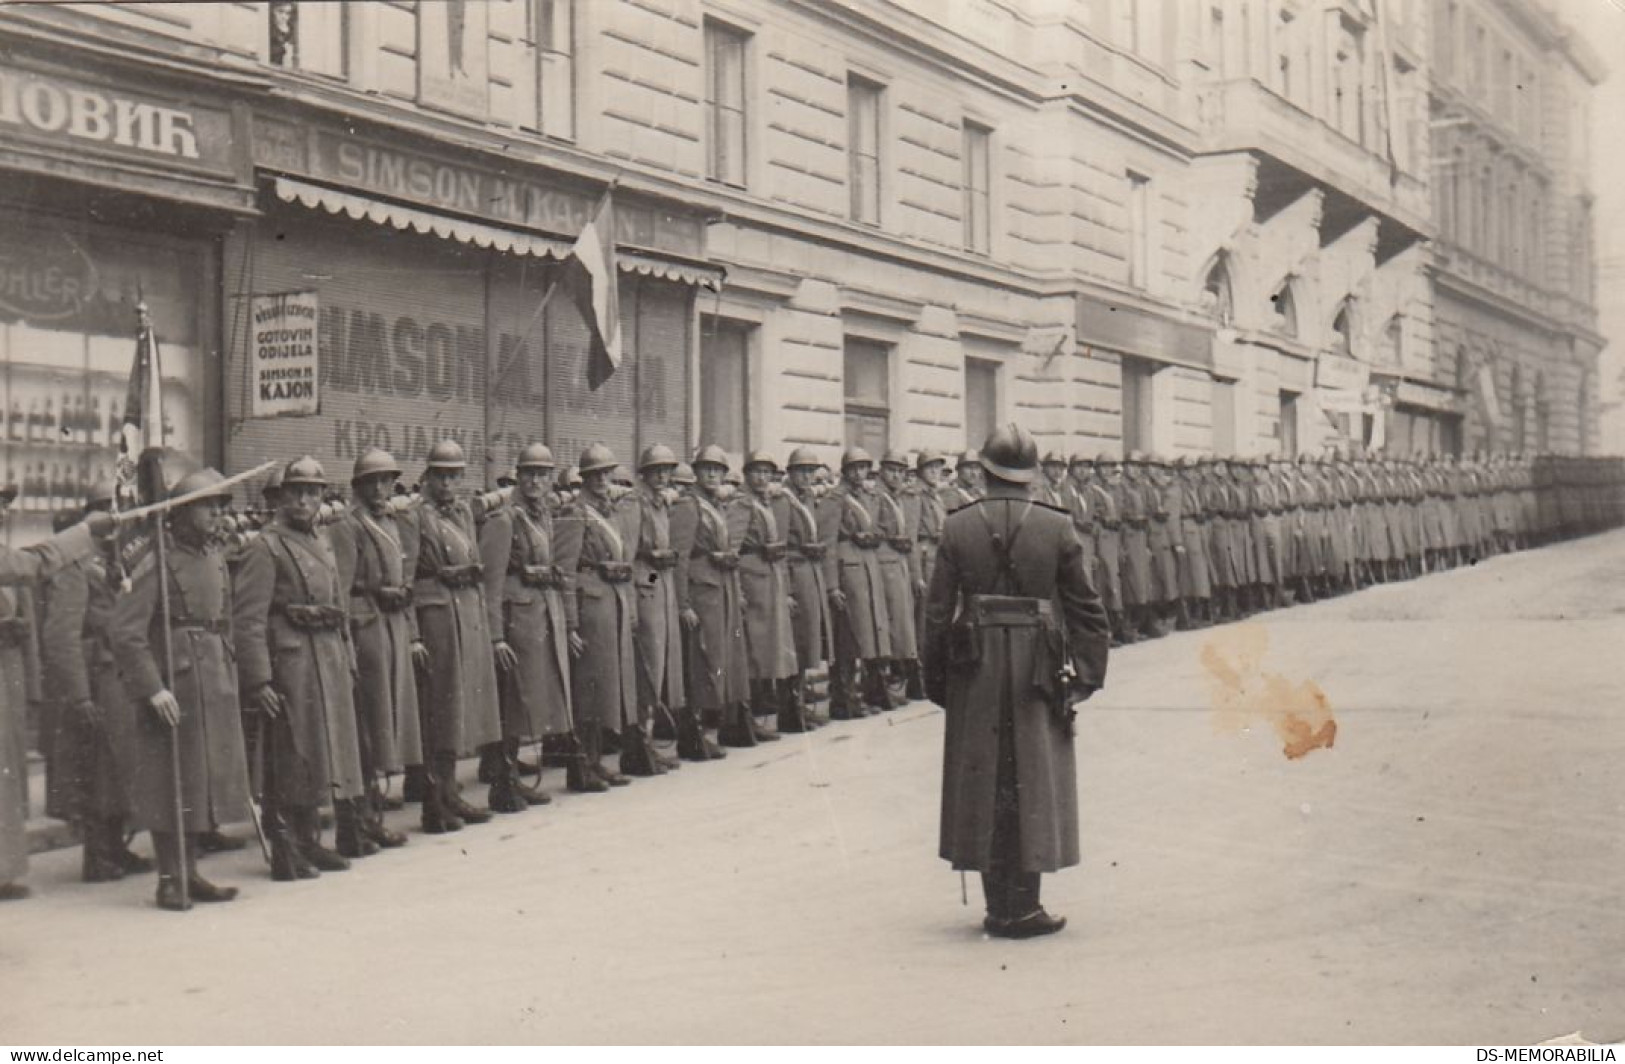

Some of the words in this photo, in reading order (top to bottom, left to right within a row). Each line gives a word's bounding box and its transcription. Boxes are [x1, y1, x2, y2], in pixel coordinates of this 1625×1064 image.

[338, 143, 480, 209] SIMSON
[531, 187, 636, 242] KAJN
[257, 329, 313, 345] GOTOVIH
[258, 345, 313, 360] ODIJELA
[260, 382, 313, 400] KAJON
